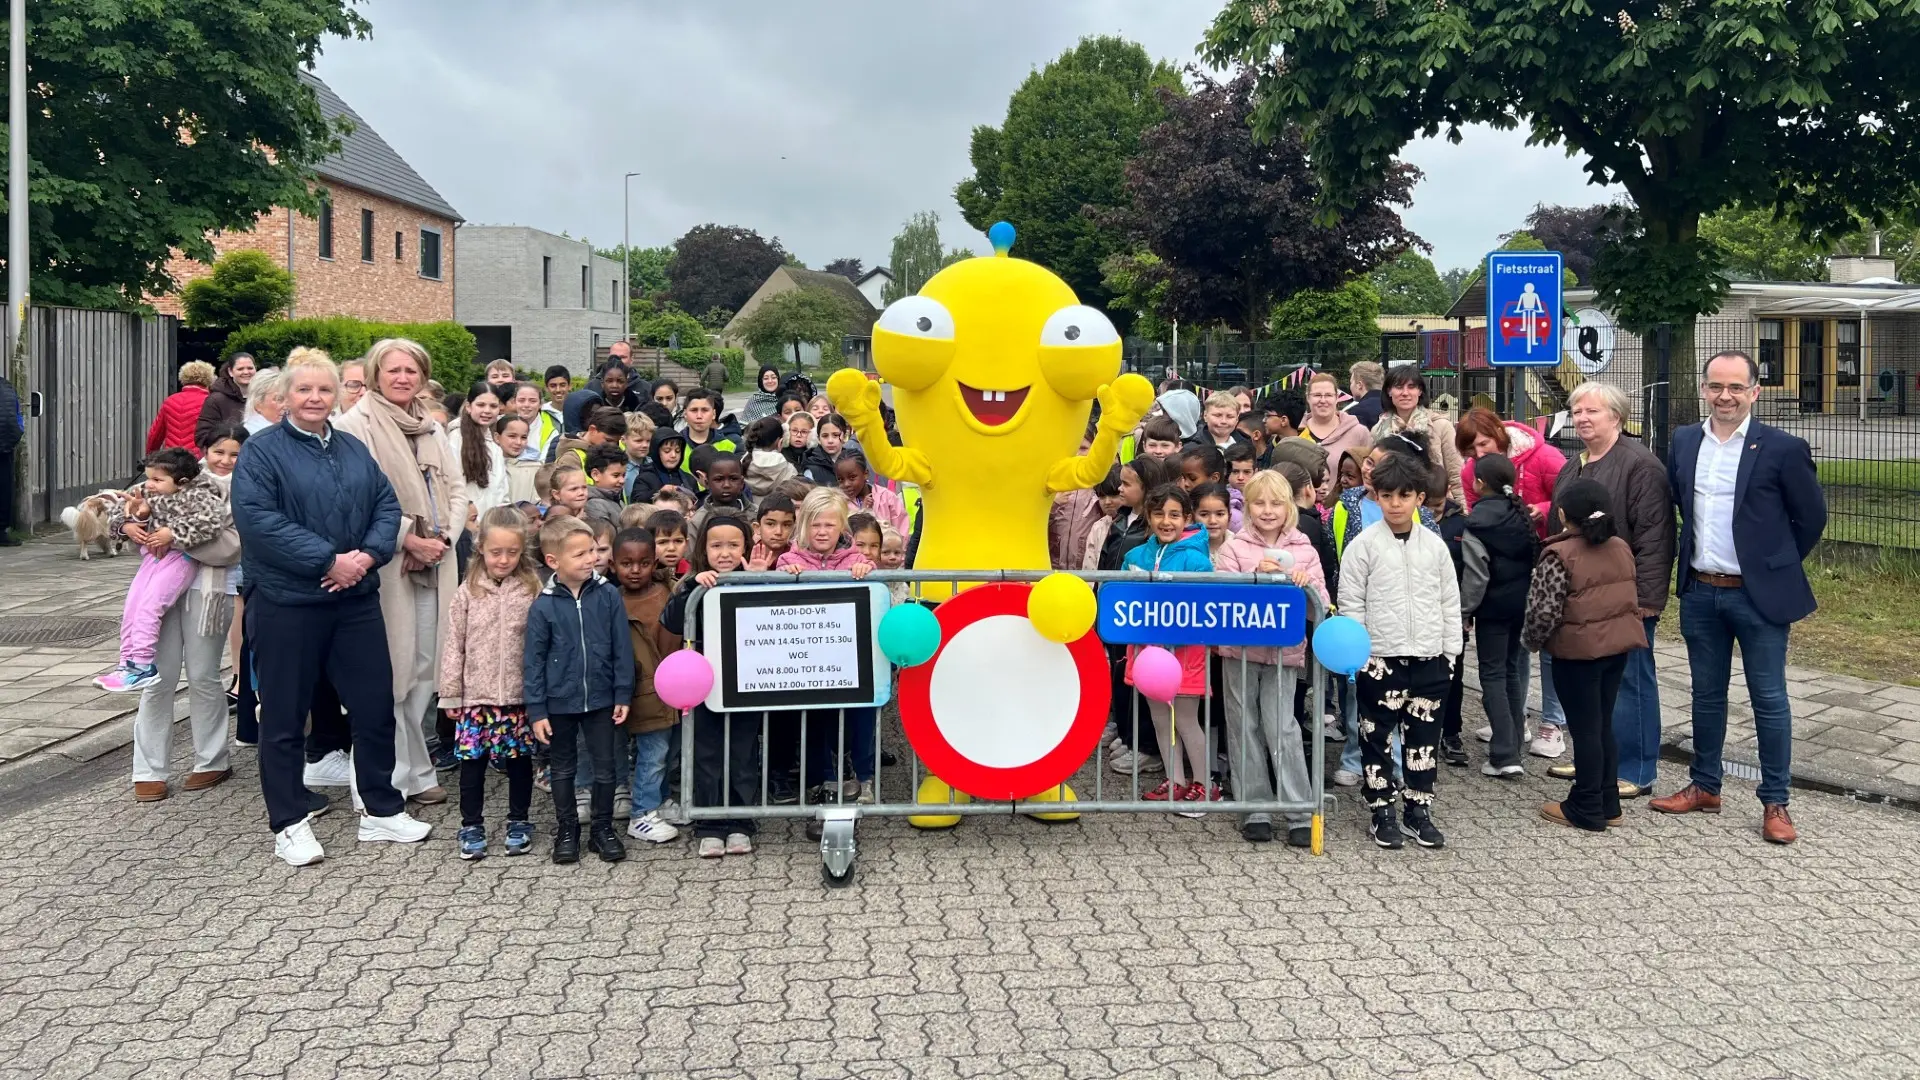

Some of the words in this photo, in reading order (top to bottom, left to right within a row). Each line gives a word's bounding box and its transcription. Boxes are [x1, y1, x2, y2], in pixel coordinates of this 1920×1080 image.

[1496, 264, 1554, 274] Fietsstraat
[770, 607, 827, 616] MA-DI-DO-VR
[1113, 600, 1290, 628] SCHOOLSTRAAT
[756, 623, 774, 632] VAN
[775, 623, 799, 631] 8.00u
[800, 622, 816, 630] TOT
[818, 621, 841, 629] 8.45u
[744, 639, 756, 647] EN
[758, 638, 776, 646] VAN
[778, 637, 806, 645] 14.45u
[807, 636, 824, 644] TOT
[825, 635, 852, 644] 15.30u
[788, 651, 809, 660] WOE
[756, 667, 774, 675] VAN
[776, 666, 799, 674] 8.00u
[819, 665, 842, 673] 8.45u
[744, 682, 756, 690] EN
[758, 681, 776, 690] VAN
[778, 681, 806, 689] 12.00u
[808, 680, 824, 688] TOT
[825, 679, 853, 687] 12.45u
